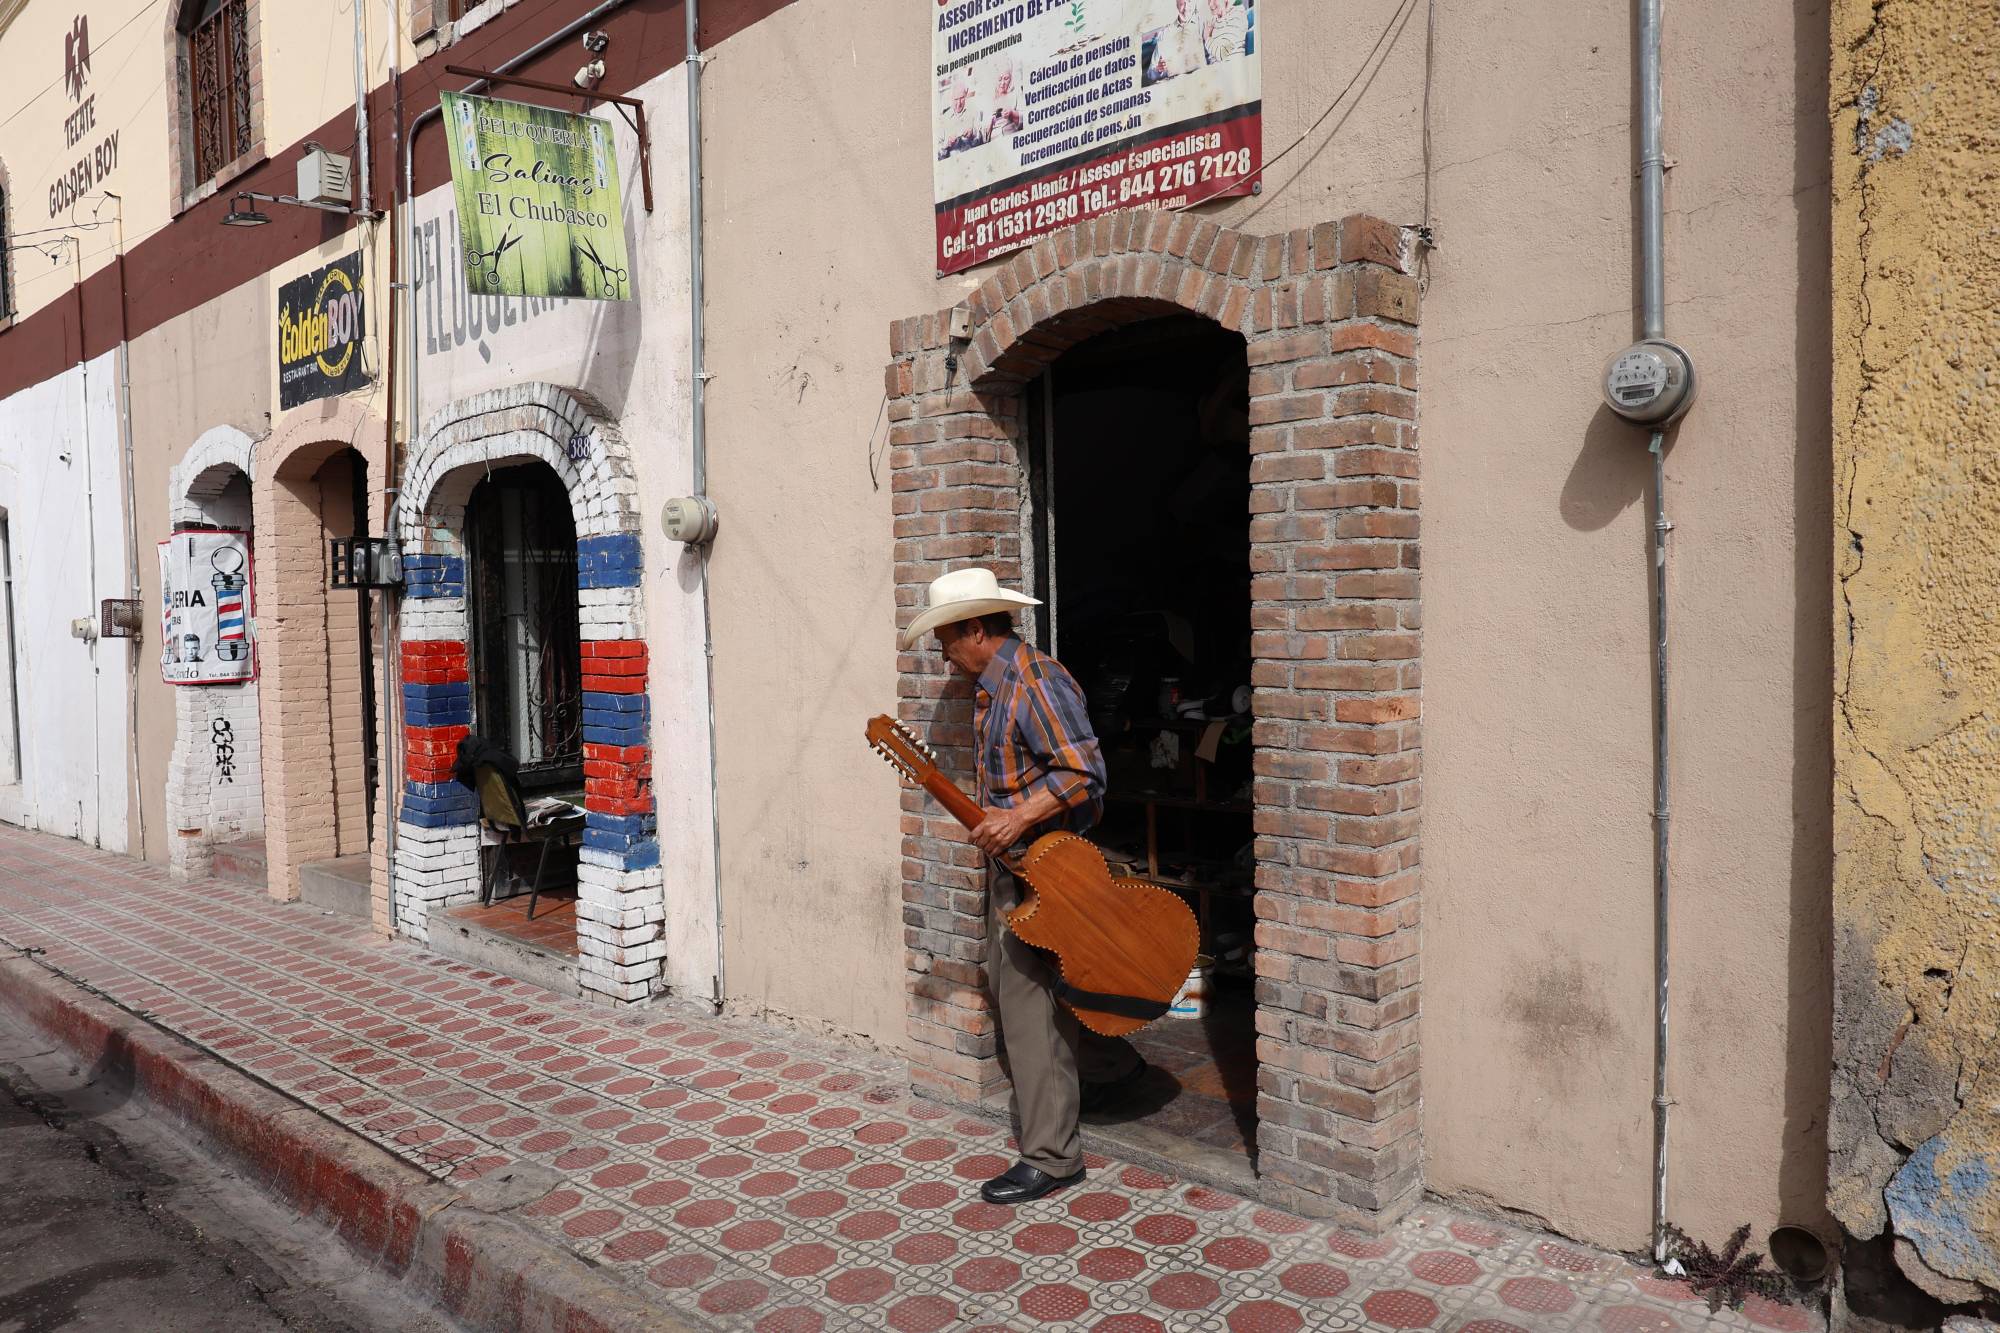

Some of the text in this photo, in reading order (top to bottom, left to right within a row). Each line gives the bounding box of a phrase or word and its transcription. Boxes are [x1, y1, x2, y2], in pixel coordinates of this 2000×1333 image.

[938, 0, 982, 32] ASESOR
[946, 1, 1043, 53] INCREMENTO DE
[937, 64, 948, 77] Sin
[981, 32, 1022, 59] preventiva
[1030, 35, 1130, 85] Cálculo de pensión
[1025, 54, 1136, 106] Verificación de datos
[1028, 76, 1133, 124] Corrección de Actas
[64, 92, 96, 150] TECATE
[480, 116, 589, 149] PELUQUERIA
[1012, 90, 1151, 150] Recuperación de semanas
[1020, 135, 1079, 167] Incremento
[1081, 129, 1094, 144] de
[49, 128, 119, 219] GOLDEN BOY
[484, 153, 593, 195] Salinas
[963, 203, 989, 225] Juan
[990, 189, 1029, 215] Carlos
[1080, 158, 1126, 187] Asesor
[1128, 131, 1221, 171] Especialista
[996, 208, 1032, 239] 1531
[1035, 194, 1078, 229] 2930
[1081, 184, 1116, 213] Tel.:
[1120, 170, 1156, 202] 844
[1160, 160, 1196, 192] 276
[1200, 147, 1251, 182] 2128
[478, 192, 608, 229] El Chubasco
[570, 437, 590, 460] 388
